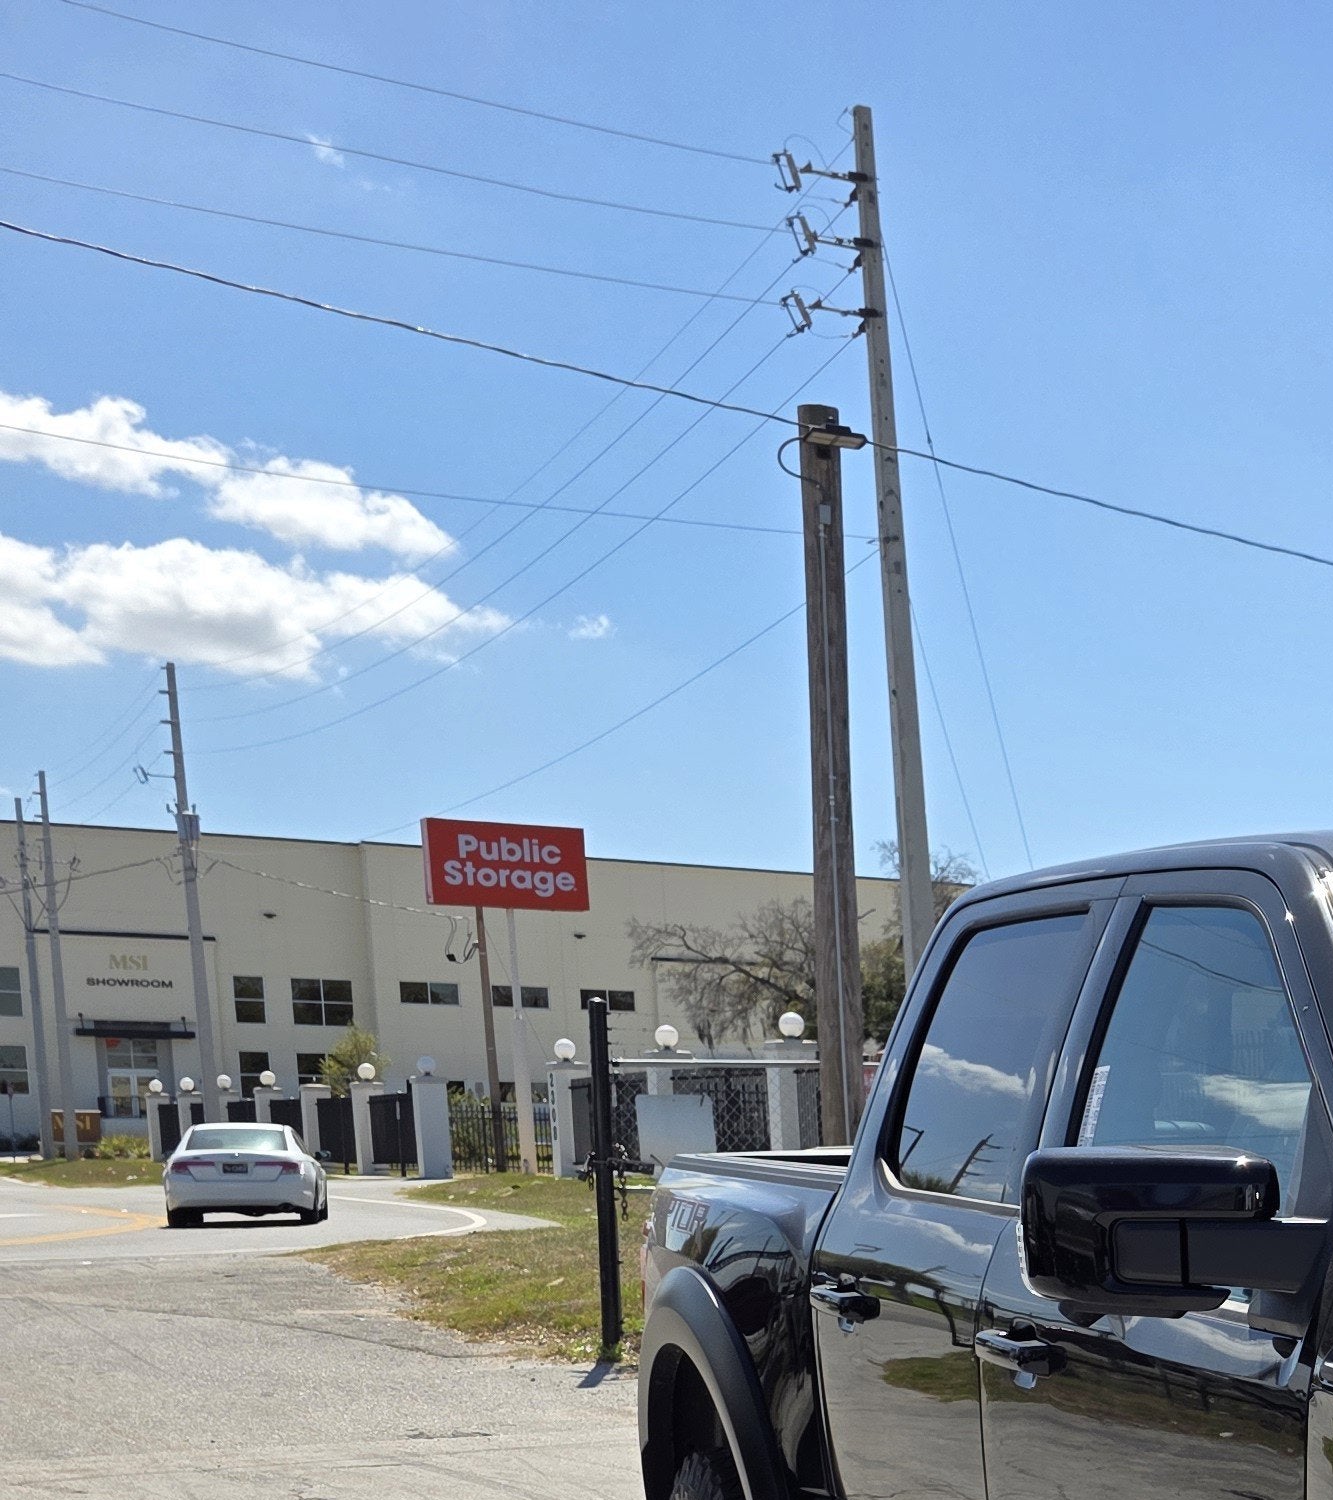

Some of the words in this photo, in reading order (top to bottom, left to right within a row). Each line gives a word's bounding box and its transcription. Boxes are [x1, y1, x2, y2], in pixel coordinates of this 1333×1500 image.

[457, 834, 562, 864] Public
[443, 860, 576, 897] Storage
[108, 954, 149, 971] MSI
[86, 977, 173, 989] SHOWROOM
